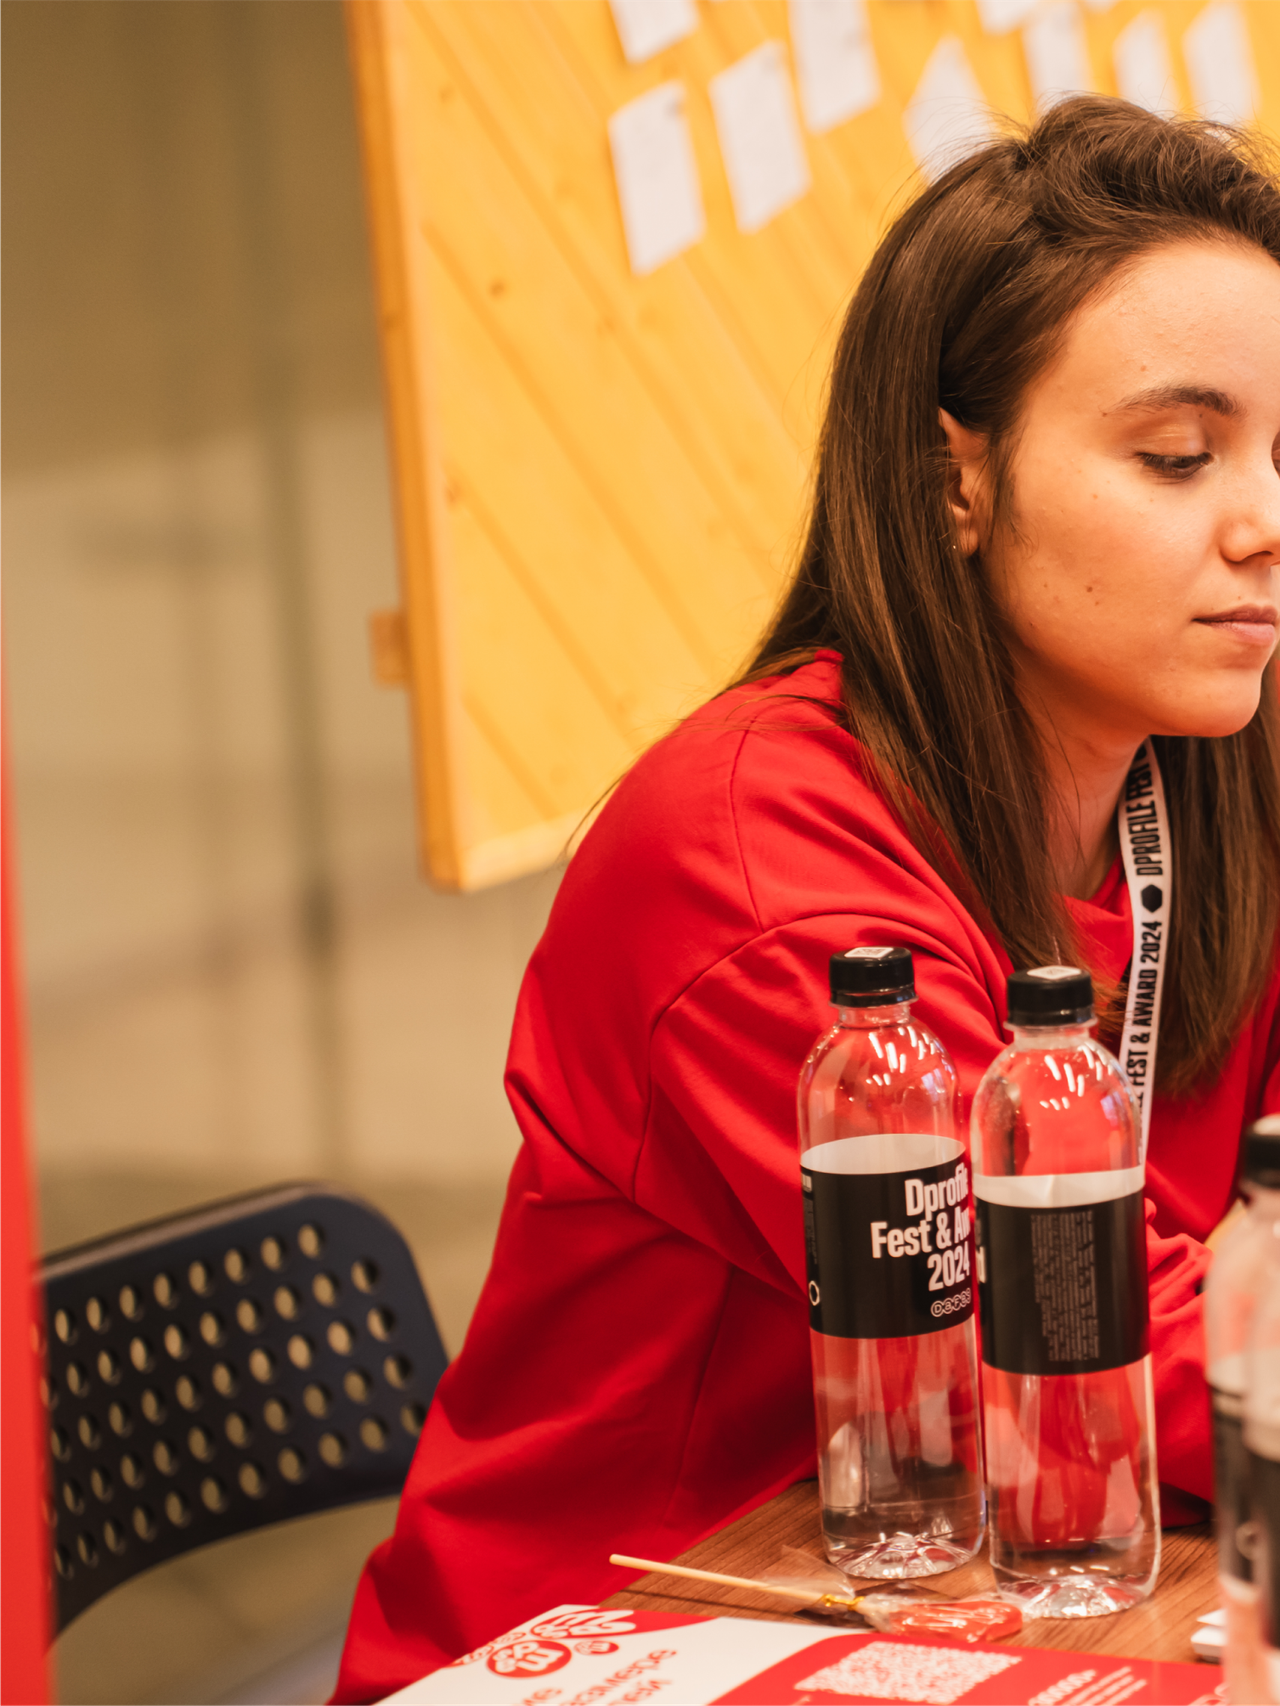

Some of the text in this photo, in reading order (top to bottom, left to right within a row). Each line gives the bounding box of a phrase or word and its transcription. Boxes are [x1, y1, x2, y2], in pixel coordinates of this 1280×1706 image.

[1125, 799, 1164, 876] DPROFILE
[1140, 920, 1163, 964] 2024
[1132, 968, 1158, 1027] AWARD
[1130, 1032, 1151, 1045] &
[1126, 1049, 1149, 1087] FEST
[870, 1219, 932, 1259] Fest
[936, 1212, 952, 1250] &
[927, 1240, 970, 1292] 2024
